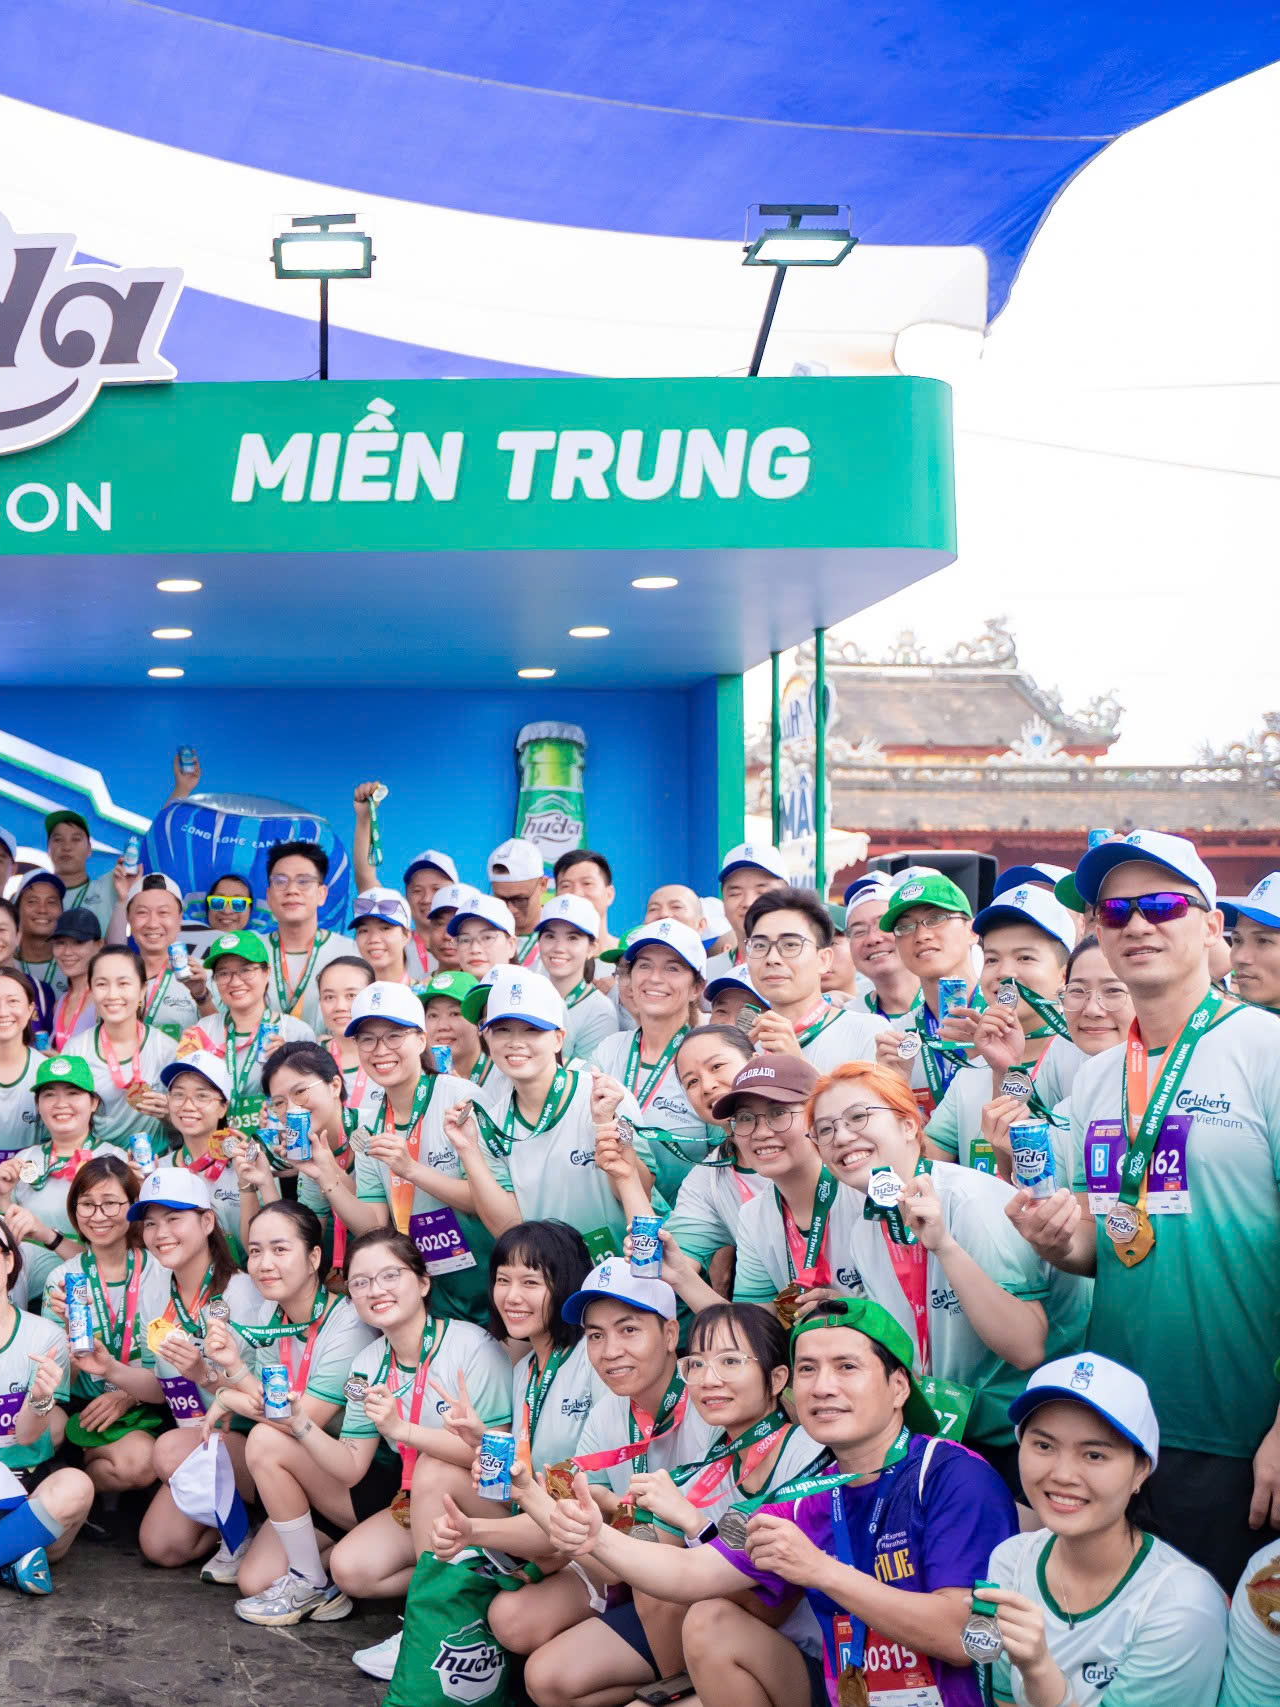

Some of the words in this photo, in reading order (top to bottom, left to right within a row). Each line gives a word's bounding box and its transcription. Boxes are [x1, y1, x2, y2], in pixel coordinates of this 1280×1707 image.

[231, 397, 464, 502] MIỀN
[497, 426, 812, 501] TRUNG
[523, 811, 581, 843] huda
[1190, 1008, 1210, 1031] huda
[1002, 1081, 1030, 1097] huda
[1145, 1115, 1159, 1136] ĐẬM
[1153, 1093, 1170, 1118] TÌNH
[1163, 1067, 1179, 1095] MIỀN
[1174, 1042, 1191, 1070] TRUNG
[1176, 1089, 1231, 1114] Carlsberg
[1196, 1112, 1243, 1130] Vietnam
[1094, 1149, 1105, 1171] B
[1128, 1152, 1146, 1178] huda
[214, 1189, 240, 1202] Carlsber
[1107, 1215, 1137, 1235] huda
[415, 1229, 461, 1253] 60203
[964, 1629, 999, 1651] huda
[434, 1639, 505, 1685] huda
[1082, 1661, 1118, 1689] Carls
